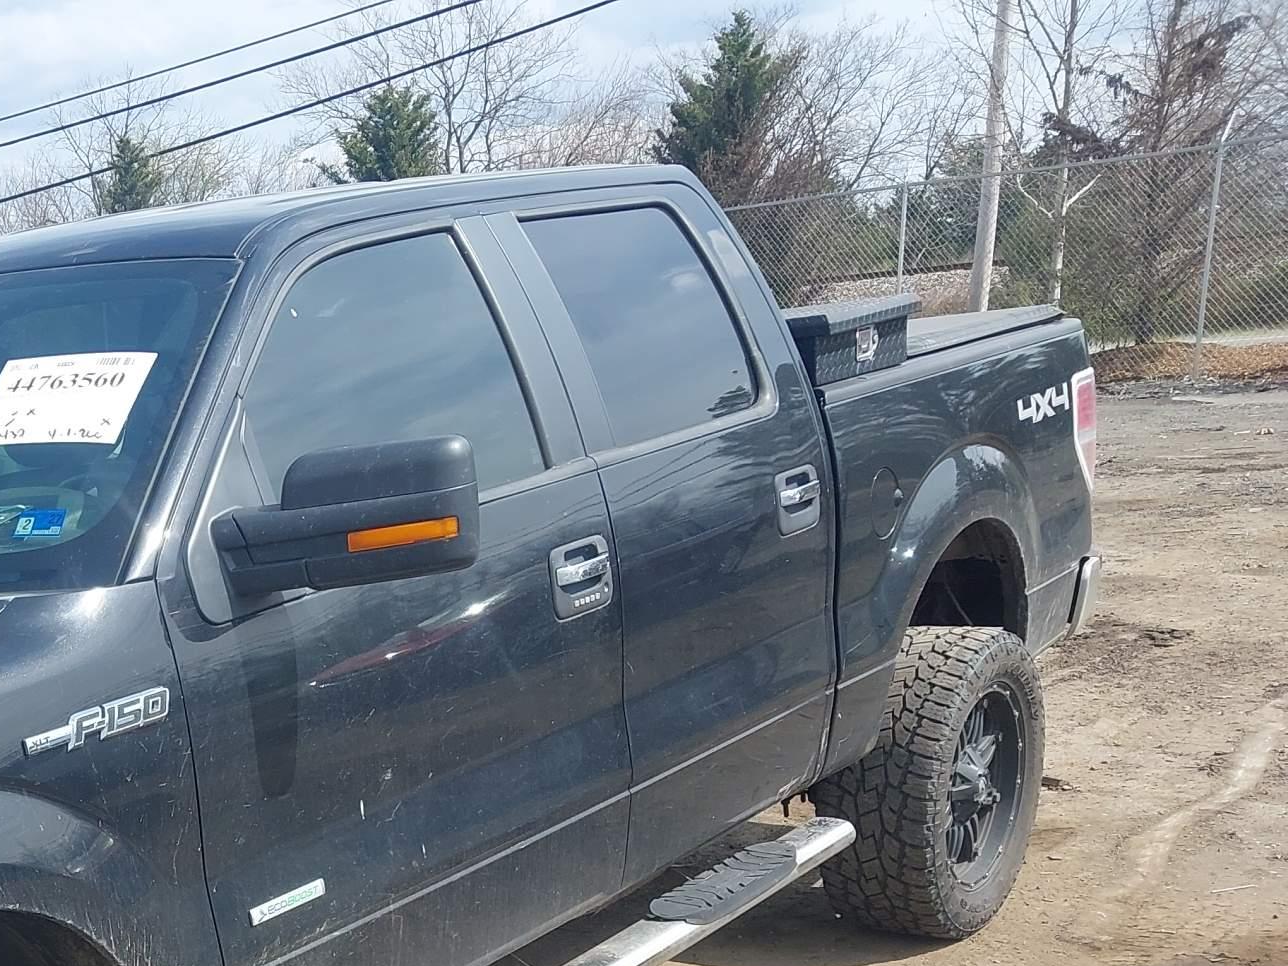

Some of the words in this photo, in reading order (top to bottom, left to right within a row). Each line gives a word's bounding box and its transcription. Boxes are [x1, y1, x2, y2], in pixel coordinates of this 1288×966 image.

[7, 371, 126, 393] 44763560
[22, 518, 32, 531] 2
[30, 735, 51, 749] XLT
[67, 686, 170, 753] F-150
